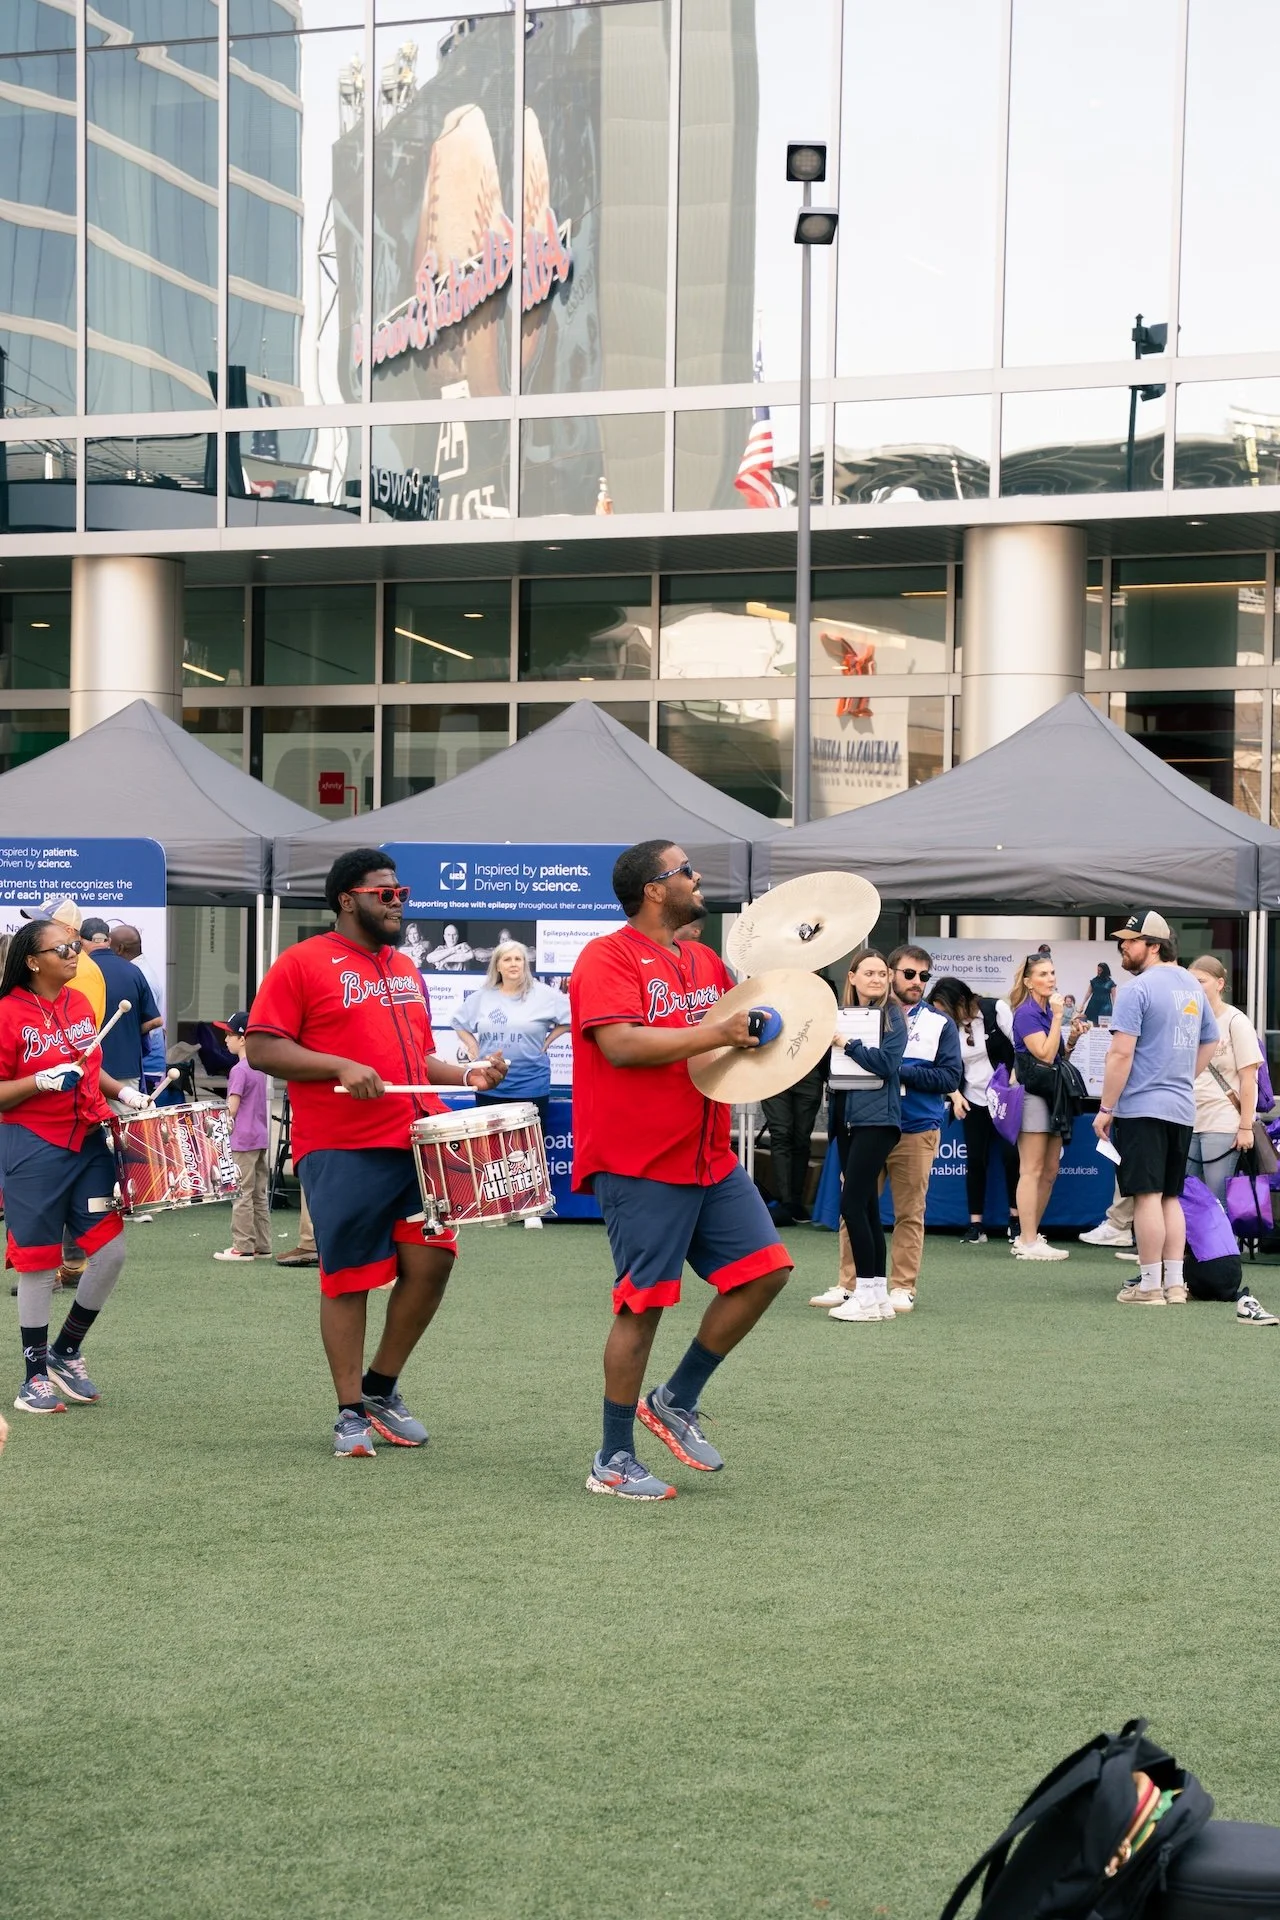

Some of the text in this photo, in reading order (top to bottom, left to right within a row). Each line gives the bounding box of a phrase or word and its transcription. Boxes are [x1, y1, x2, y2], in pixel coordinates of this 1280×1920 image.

[0, 848, 79, 858] nspired by patients.
[25, 859, 35, 869] by
[37, 859, 72, 869] science.
[474, 863, 591, 879] Inspired by patients.
[0, 879, 133, 892] atments that recognizes the
[474, 879, 581, 894] Driven by science.
[5, 890, 16, 900] of
[17, 890, 41, 900] each
[43, 891, 79, 901] person
[80, 892, 95, 901] we
[97, 892, 124, 901] serve
[408, 900, 448, 909] Supporting
[449, 900, 469, 908] those
[470, 900, 487, 909] with
[487, 901, 517, 910] epilepsy
[518, 901, 558, 910] throughout
[559, 902, 576, 910] their
[930, 953, 1015, 963] Seizures are shared.
[952, 964, 973, 974] hope
[975, 964, 982, 973] is
[984, 965, 1002, 973] too.
[340, 970, 418, 1008] Braves
[22, 1017, 94, 1063] Braves
[510, 1033, 523, 1043] UP
[930, 1163, 968, 1176] nabidi
[1058, 1166, 1099, 1175] aceuticals
